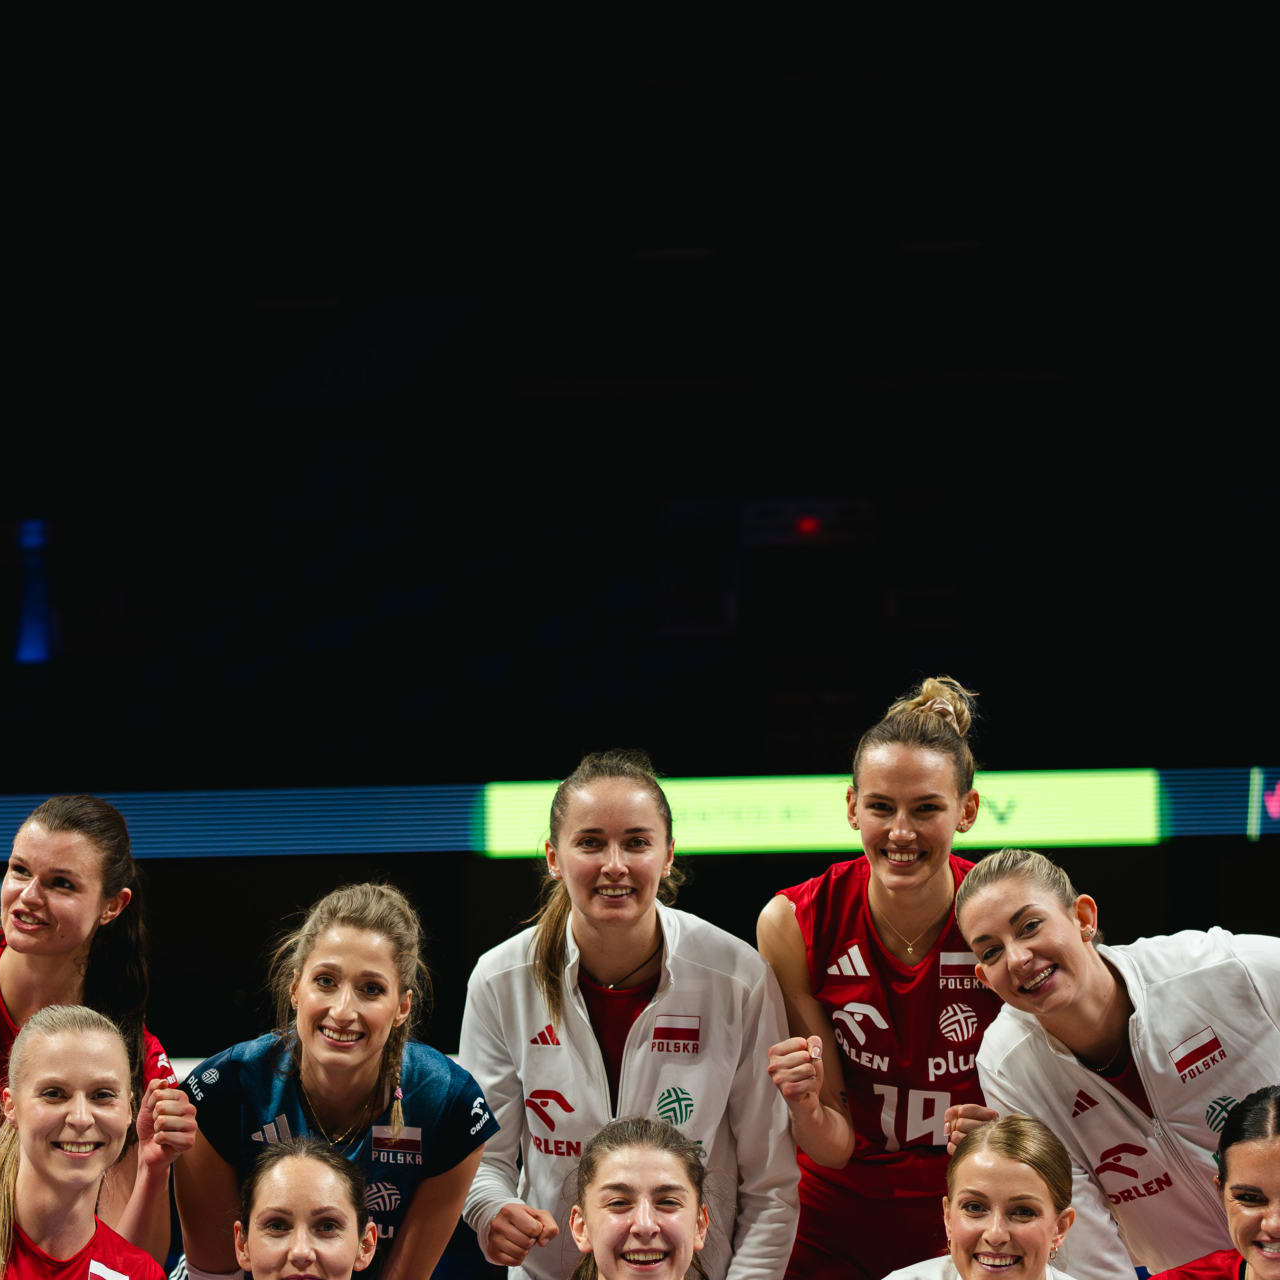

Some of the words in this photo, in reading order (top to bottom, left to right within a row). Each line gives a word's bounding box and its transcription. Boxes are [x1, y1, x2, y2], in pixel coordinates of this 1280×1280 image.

[939, 978, 989, 990] POLSK
[651, 1040, 700, 1054] POLSKA
[928, 1050, 975, 1082] plu
[1180, 1049, 1228, 1085] POLSKA
[186, 1074, 205, 1101] plus
[530, 1134, 581, 1157] RLEN
[371, 1151, 423, 1165] POLSKA
